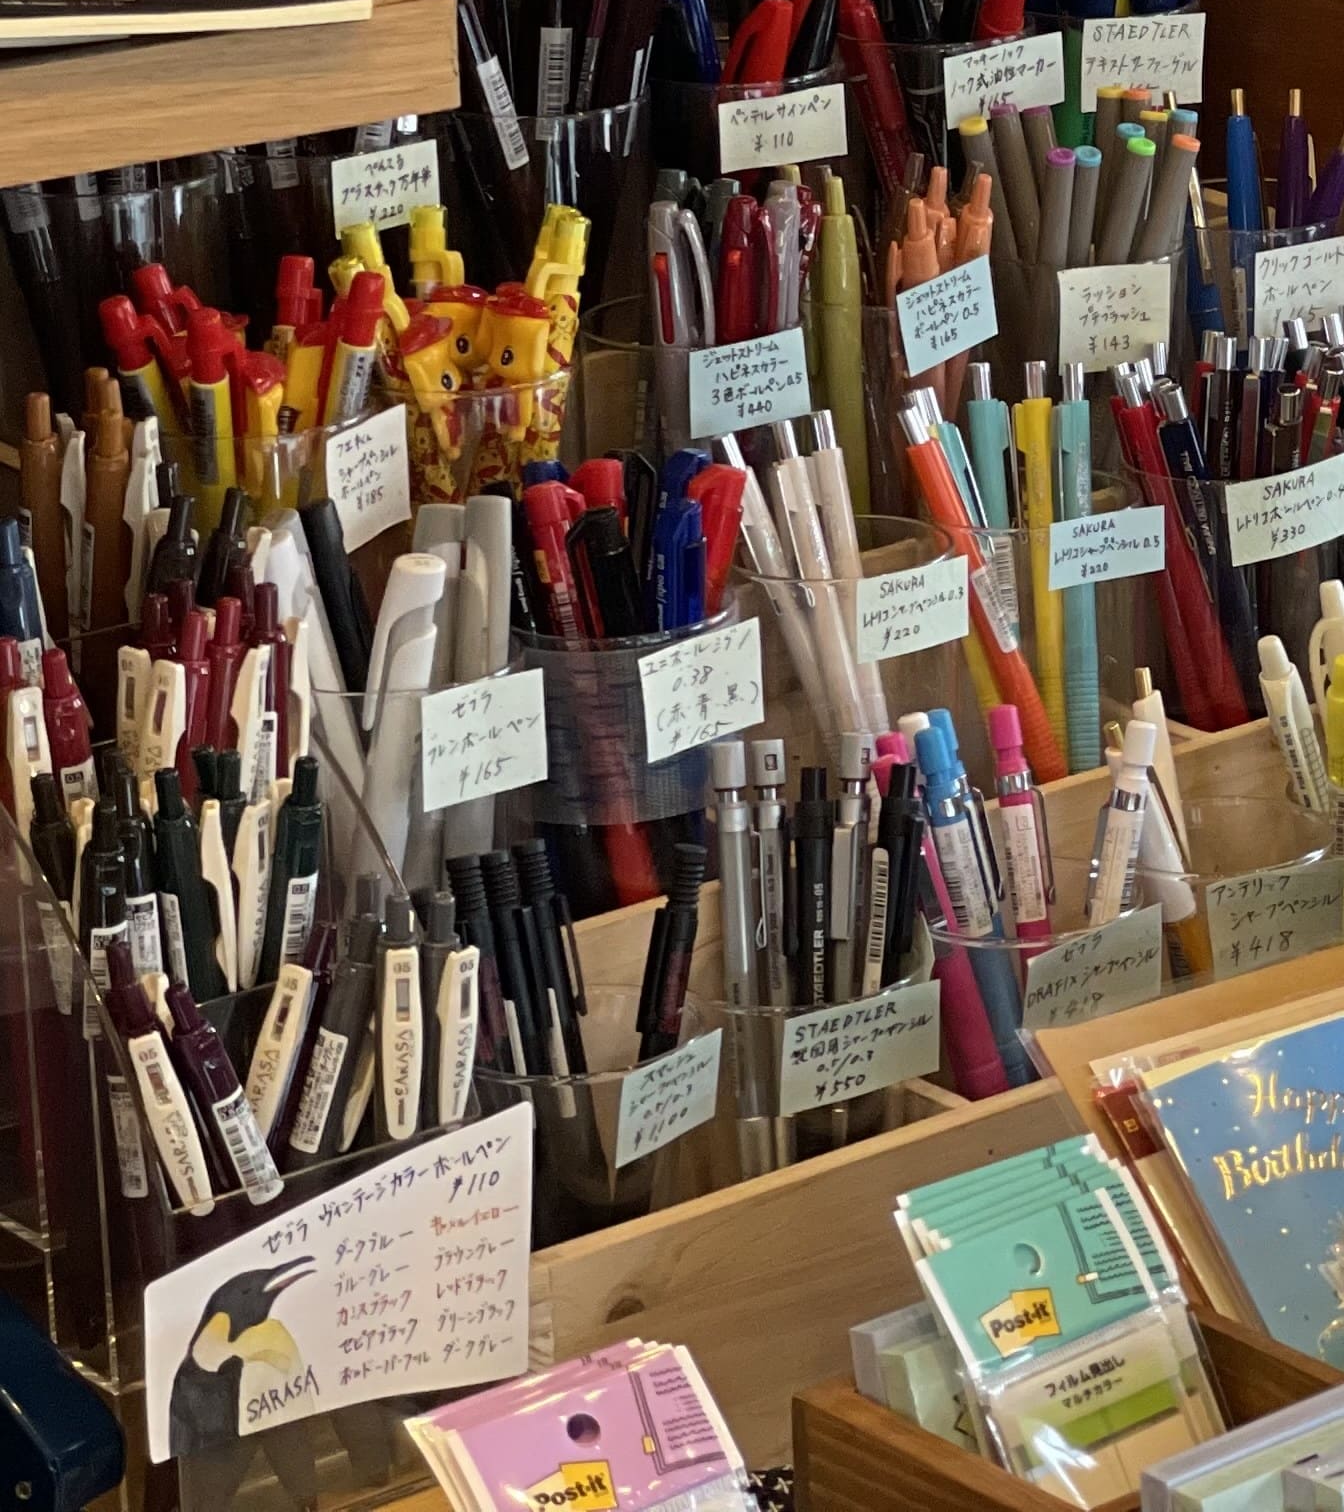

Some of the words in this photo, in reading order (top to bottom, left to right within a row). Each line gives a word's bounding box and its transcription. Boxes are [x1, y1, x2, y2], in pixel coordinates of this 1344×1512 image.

[1092, 22, 1193, 44] STAEDTLER
[1262, 471, 1316, 500] SAKURA
[1072, 517, 1117, 539] SAKURA
[879, 575, 926, 600] SAKURA
[794, 1000, 898, 1044] STAEDTLER
[261, 1220, 309, 1255] ゼブラ
[335, 1230, 415, 1265] ダークブルー
[990, 1300, 1054, 1339] Post-it
[1043, 1354, 1126, 1398] フィルム見出し
[245, 1364, 322, 1424] SARASA
[534, 1471, 609, 1512] Post-it
